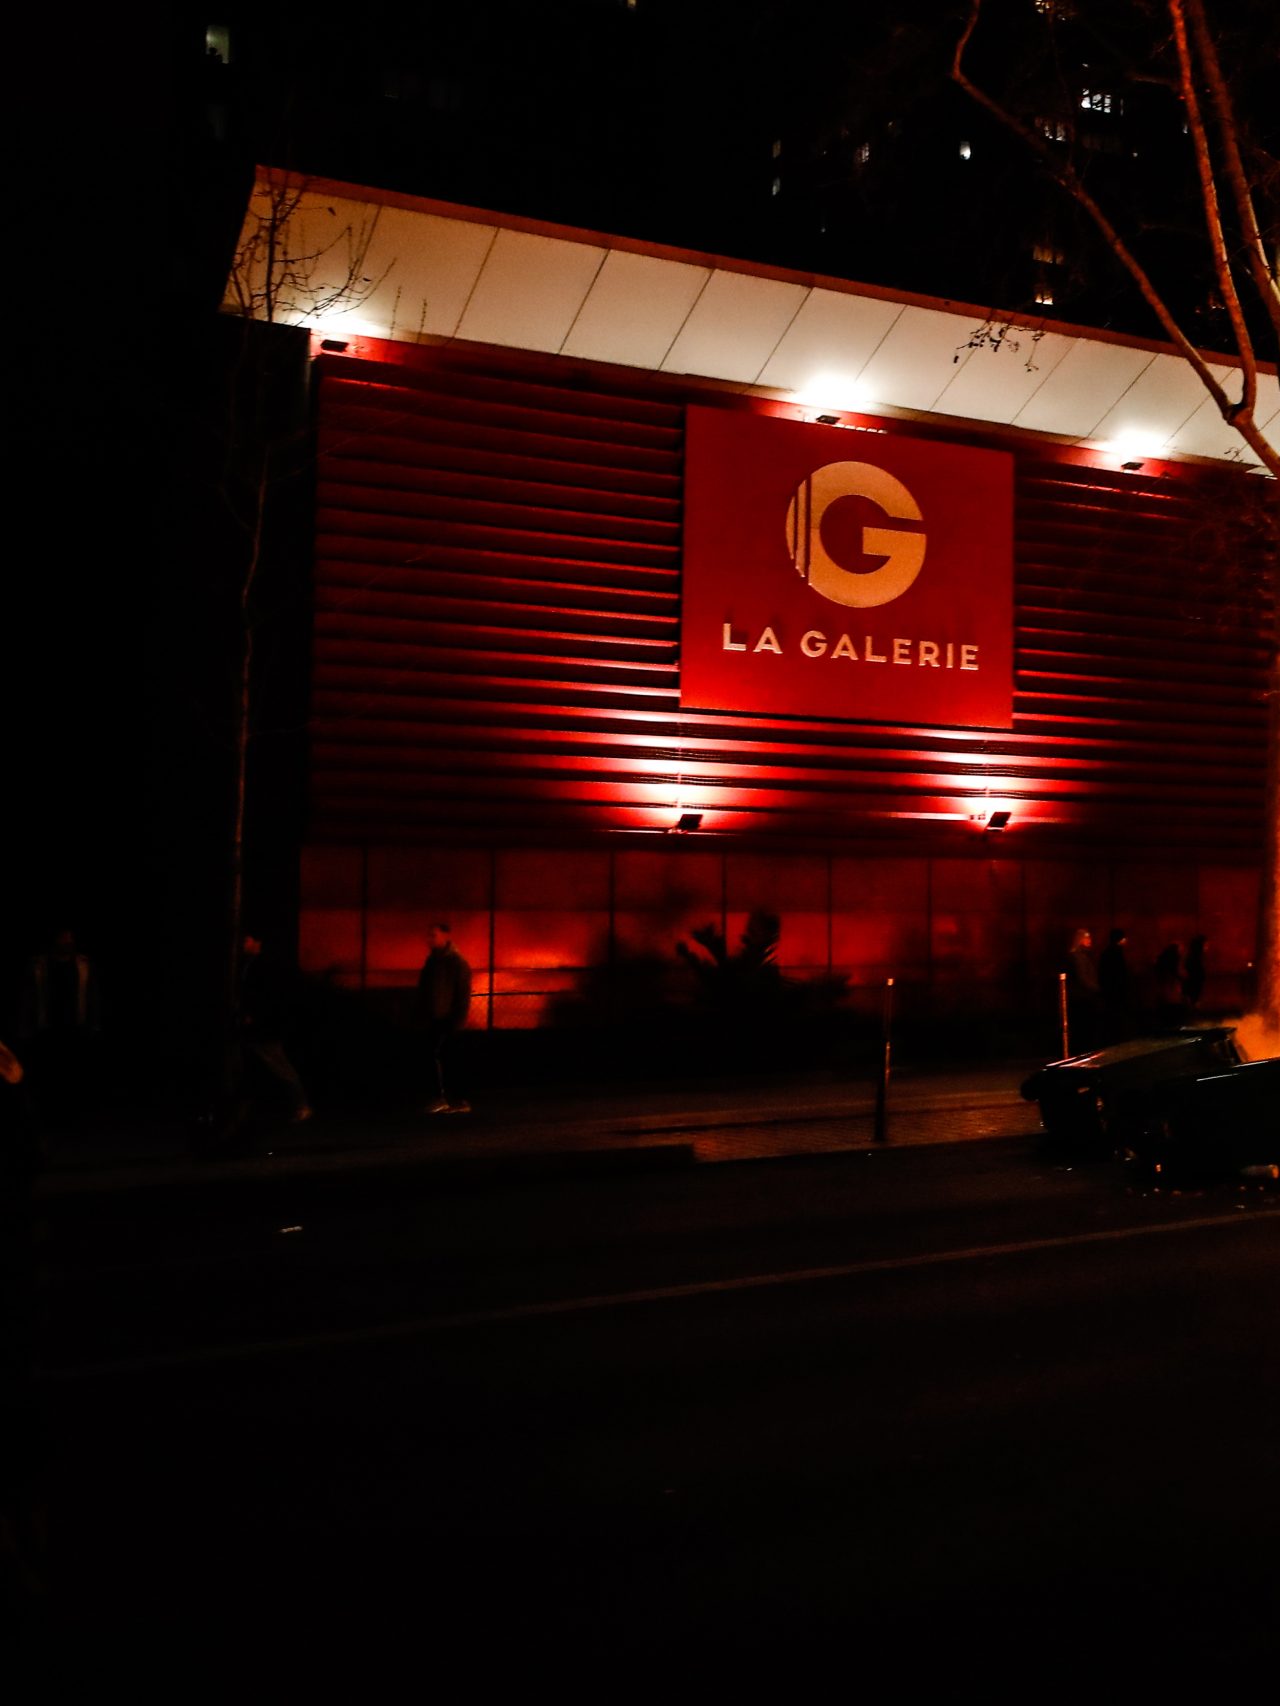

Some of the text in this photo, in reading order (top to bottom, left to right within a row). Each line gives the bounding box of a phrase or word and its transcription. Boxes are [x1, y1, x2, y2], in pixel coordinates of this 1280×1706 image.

[785, 460, 928, 608] G
[722, 622, 980, 671] LA GALERIE
